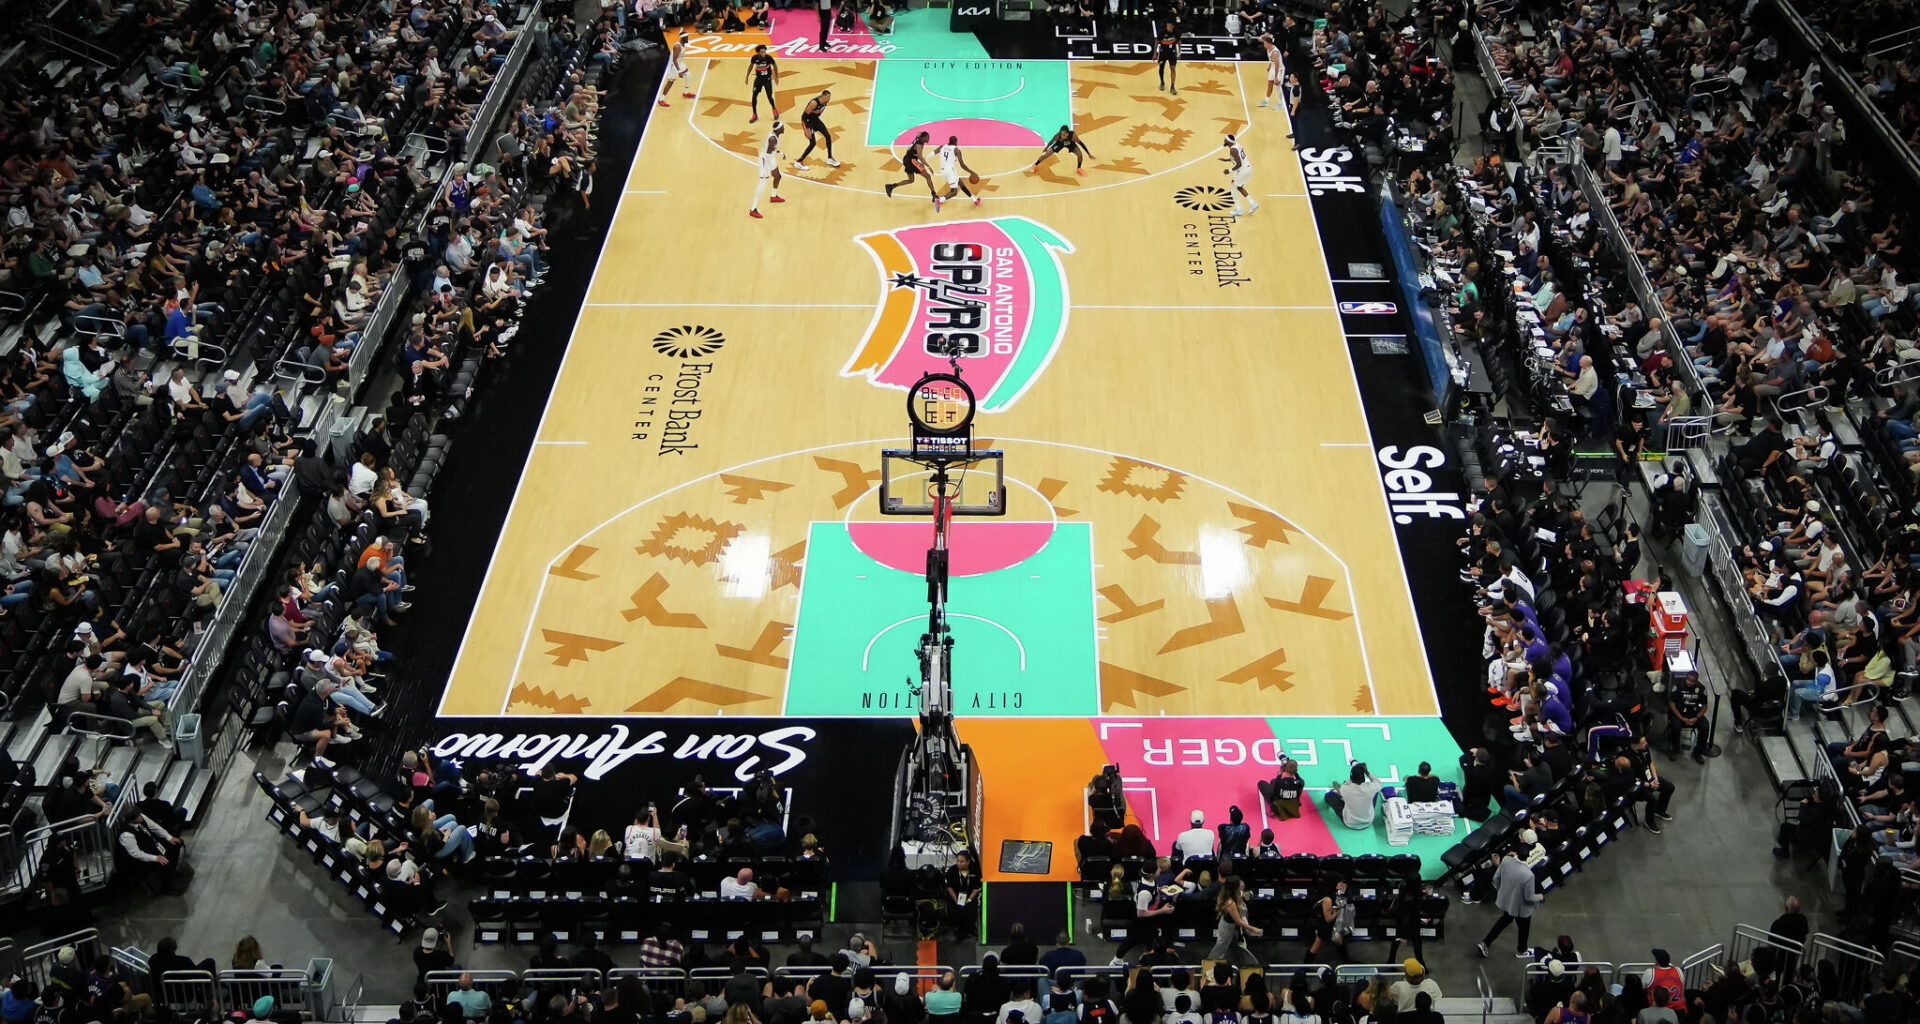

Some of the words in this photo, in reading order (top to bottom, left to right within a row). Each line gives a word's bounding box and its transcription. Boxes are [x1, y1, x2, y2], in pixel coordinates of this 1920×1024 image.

[684, 35, 760, 55] San
[1092, 43, 1216, 54] LEDER
[965, 62, 1023, 70] EDITION
[943, 151, 949, 161] 4
[1300, 147, 1365, 196] Self.
[1183, 223, 1204, 275] CENTER
[1208, 215, 1239, 248] Frost
[996, 247, 1014, 279] SAN
[1213, 251, 1252, 287] Bank
[922, 242, 992, 358] SPURS
[994, 282, 1014, 355] ANTONIO
[671, 362, 713, 405] Frost
[631, 373, 664, 440] CENTER
[658, 409, 702, 457] Bank
[1378, 444, 1465, 525] Self.
[971, 692, 1023, 709] CITY
[430, 724, 668, 781] Antonio
[673, 726, 817, 782] San
[1142, 738, 1353, 766] LEDGER
[479, 822, 498, 837] PHTO
